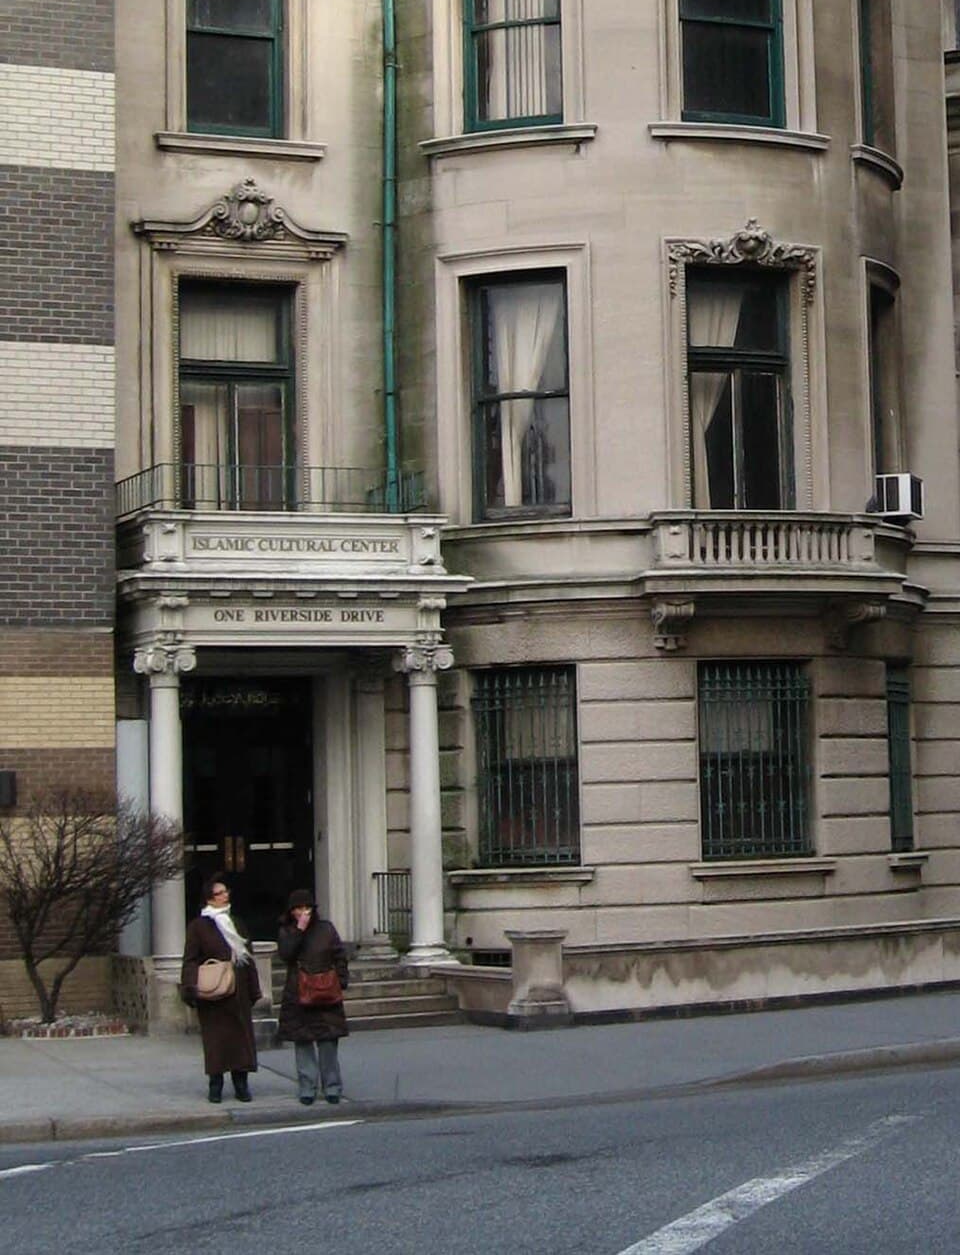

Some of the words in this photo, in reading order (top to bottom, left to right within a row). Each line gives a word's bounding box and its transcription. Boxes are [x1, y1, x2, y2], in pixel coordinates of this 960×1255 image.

[191, 537, 255, 552] ISLAMIC
[257, 538, 336, 553] CULTURAL
[340, 540, 400, 554] CENTER
[214, 609, 246, 623] ONE
[254, 609, 333, 623] RIVERSIDE
[340, 609, 385, 623] DRIVE
